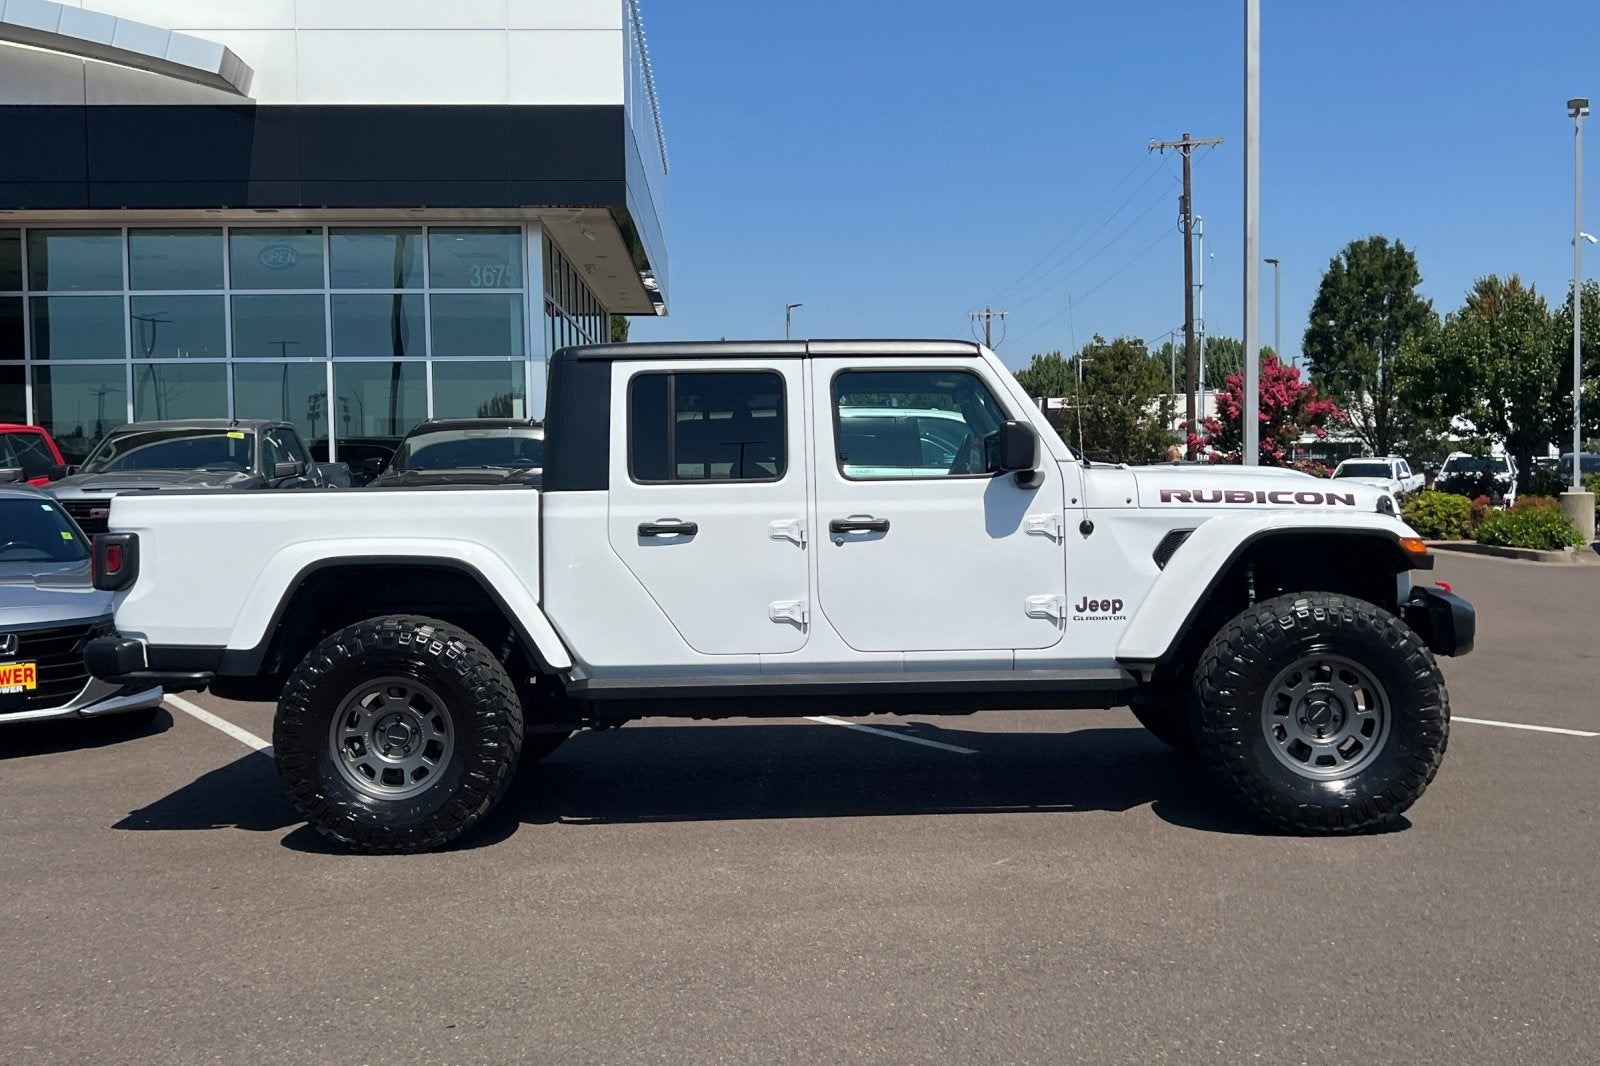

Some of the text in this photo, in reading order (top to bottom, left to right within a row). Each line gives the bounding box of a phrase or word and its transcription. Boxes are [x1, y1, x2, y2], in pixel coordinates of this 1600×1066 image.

[261, 249, 296, 265] OPEN
[470, 264, 516, 287] 3675
[1160, 488, 1356, 506] RUBICON
[1075, 596, 1124, 615] Jeep
[0, 685, 24, 694] WER
